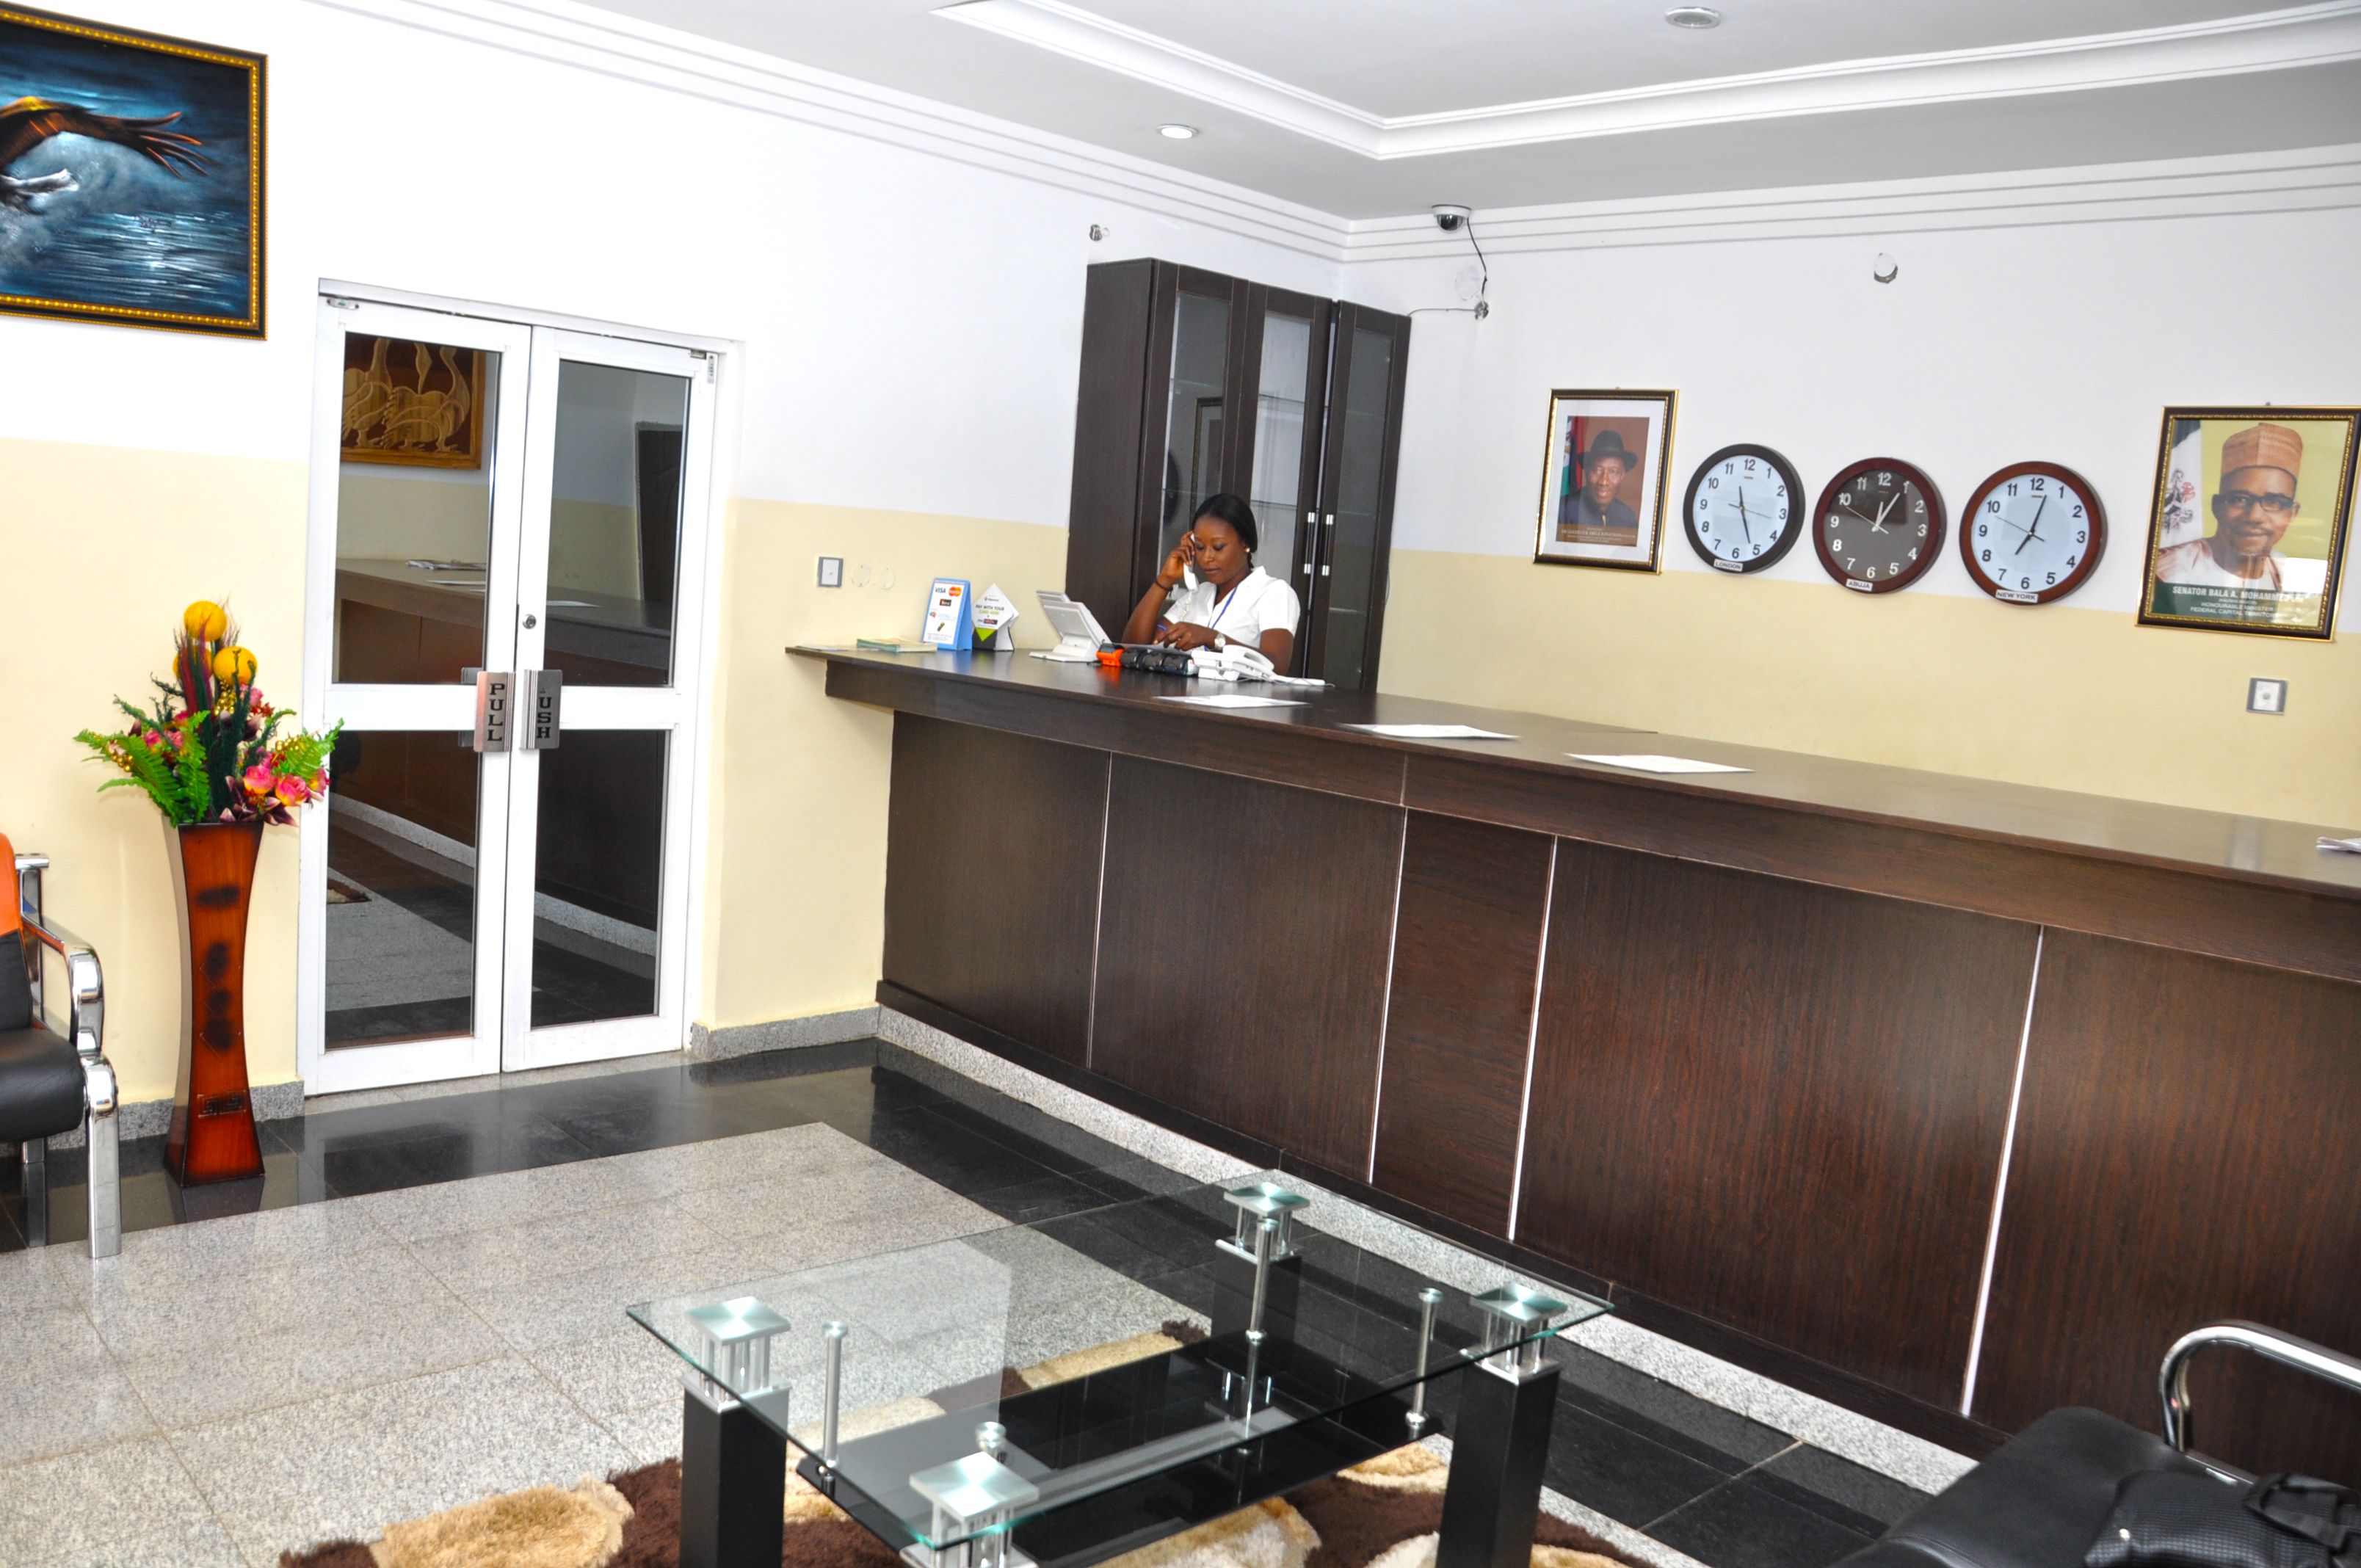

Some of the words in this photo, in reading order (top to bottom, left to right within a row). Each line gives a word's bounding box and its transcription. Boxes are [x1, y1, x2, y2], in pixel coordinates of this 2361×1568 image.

[1725, 462, 1734, 475] 11
[1744, 458, 1756, 471] 12
[1767, 467, 1771, 479] 1
[1878, 472, 1892, 486] 12
[1708, 476, 1719, 489] 10
[1857, 477, 1867, 490] 11
[1903, 480, 1910, 494] 1
[2030, 477, 2045, 491] 12
[1777, 484, 1785, 497] 2
[2007, 483, 2017, 496] 11
[2059, 485, 2064, 498] 1
[1700, 498, 1708, 510] 9
[1838, 493, 1852, 506] 10
[1915, 500, 1923, 513] 2
[1987, 500, 2001, 513] 10
[2072, 505, 2082, 518] 2
[1779, 508, 1787, 520] 3
[1701, 521, 1710, 532] 8
[1830, 515, 1839, 528] 9
[1769, 530, 1778, 542] 4
[1918, 523, 1927, 537] 3
[1979, 524, 1988, 537] 9
[2076, 531, 2086, 543] 3
[1713, 539, 1722, 550] 7
[1752, 544, 1761, 556] 5
[1832, 539, 1842, 551] 8
[1732, 547, 1740, 559] 6
[1908, 547, 1917, 560] 4
[1982, 549, 1992, 562] 8
[1715, 562, 1741, 570] LONDON
[1847, 557, 1856, 570] 7
[2066, 555, 2075, 568] 4
[1867, 567, 1876, 578] 6
[1889, 562, 1899, 575] 5
[1998, 568, 2007, 581] 7
[1848, 581, 1871, 589] ABUJA
[2021, 577, 2030, 589] 6
[2046, 572, 2056, 585] 5
[2172, 586, 2207, 595] SENATOR
[2208, 589, 2229, 598] BALA
[2230, 590, 2238, 598] A.
[487, 683, 505, 741] PULL
[537, 688, 552, 738] USH
